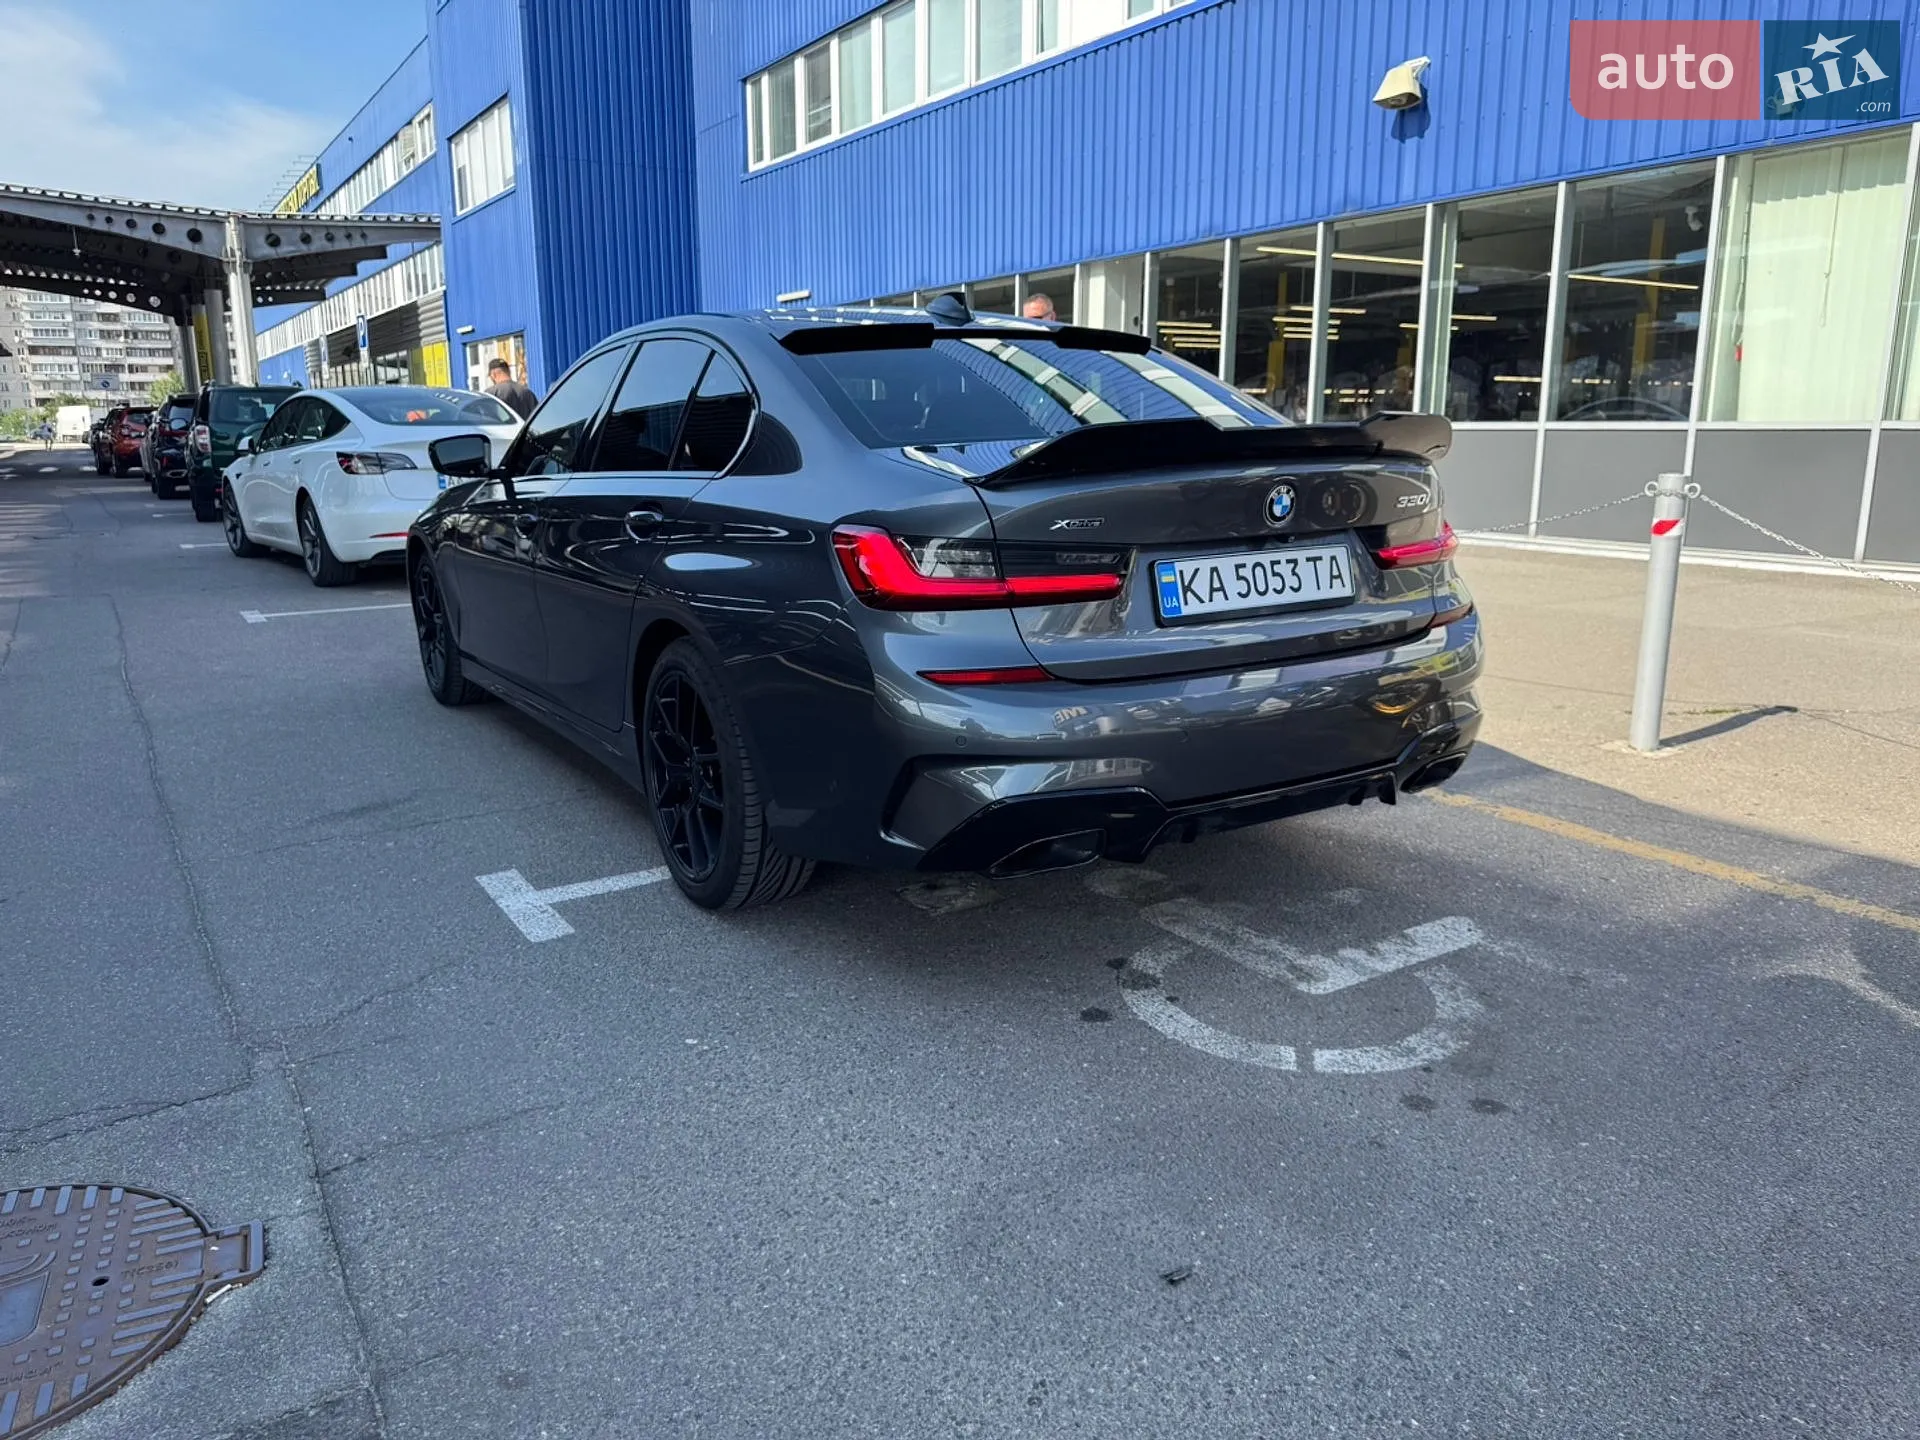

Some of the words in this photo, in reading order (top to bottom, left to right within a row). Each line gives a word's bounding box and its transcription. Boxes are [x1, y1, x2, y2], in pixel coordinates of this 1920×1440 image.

[1179, 566, 1230, 606] KA
[1234, 556, 1303, 599] 5053
[1305, 554, 1347, 591] TA
[1164, 596, 1179, 609] UA
